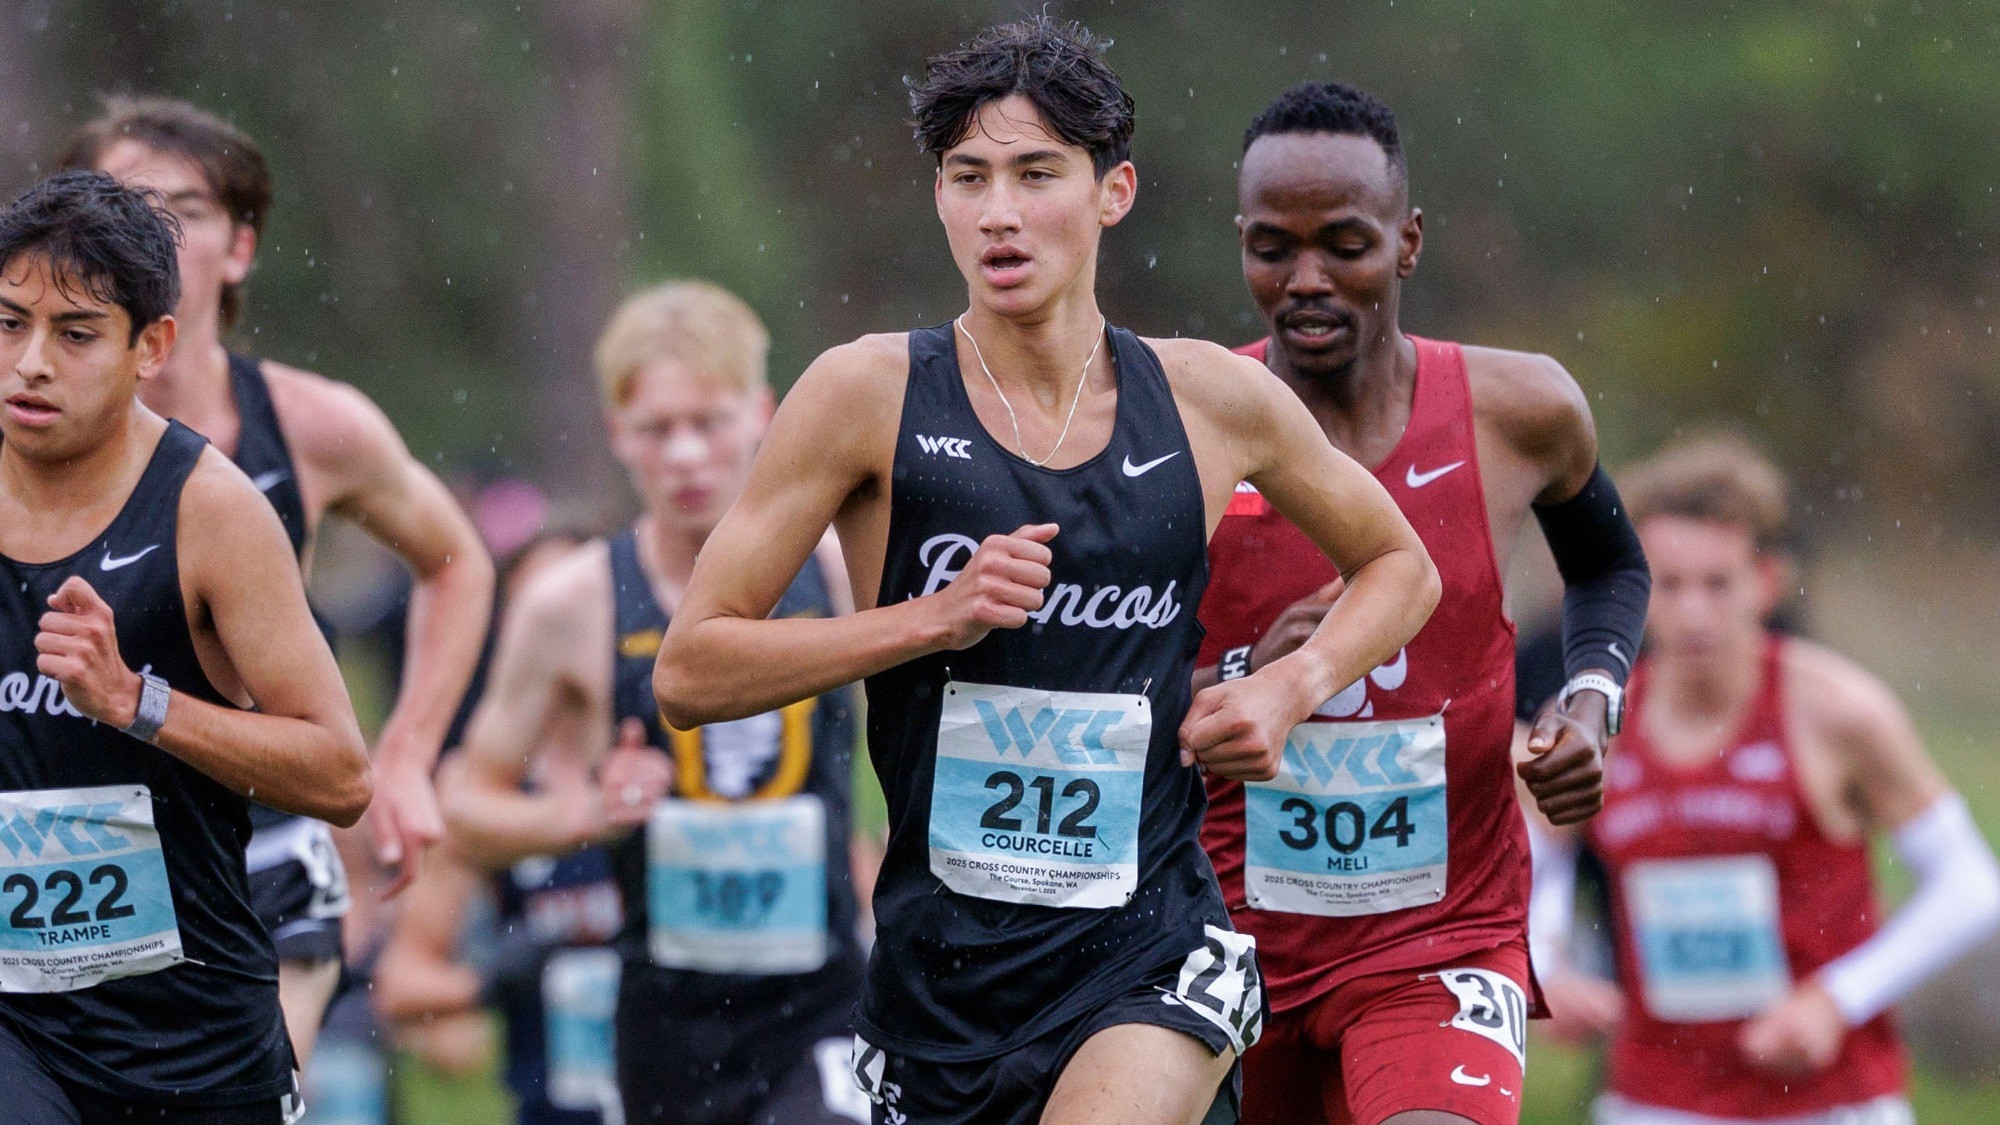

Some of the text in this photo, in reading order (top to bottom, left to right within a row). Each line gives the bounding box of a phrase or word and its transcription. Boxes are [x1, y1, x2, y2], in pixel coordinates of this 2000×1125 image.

[916, 434, 972, 459] WCC
[908, 533, 1181, 629] Bncos
[973, 699, 1126, 765] WCC
[979, 770, 1101, 839] 212
[1278, 796, 1416, 855] 304
[981, 833, 1093, 858] COURCELLE
[946, 857, 1121, 880] 2025 CROSS COUNTRY CHAMPIONSHIPS
[1327, 856, 1368, 871] MELI
[989, 873, 1078, 890] The Course, Spokane, WA
[1010, 885, 1038, 893] November
[1264, 872, 1432, 890] 2025 CROSS COUNTRY CHAMPIONSHIPS
[3, 863, 136, 929] 222
[38, 925, 112, 945] TRAMPE
[21, 957, 46, 967] CROSS
[49, 954, 90, 966] COUNTRY
[91, 940, 165, 962] CHAMPIONSHIPS
